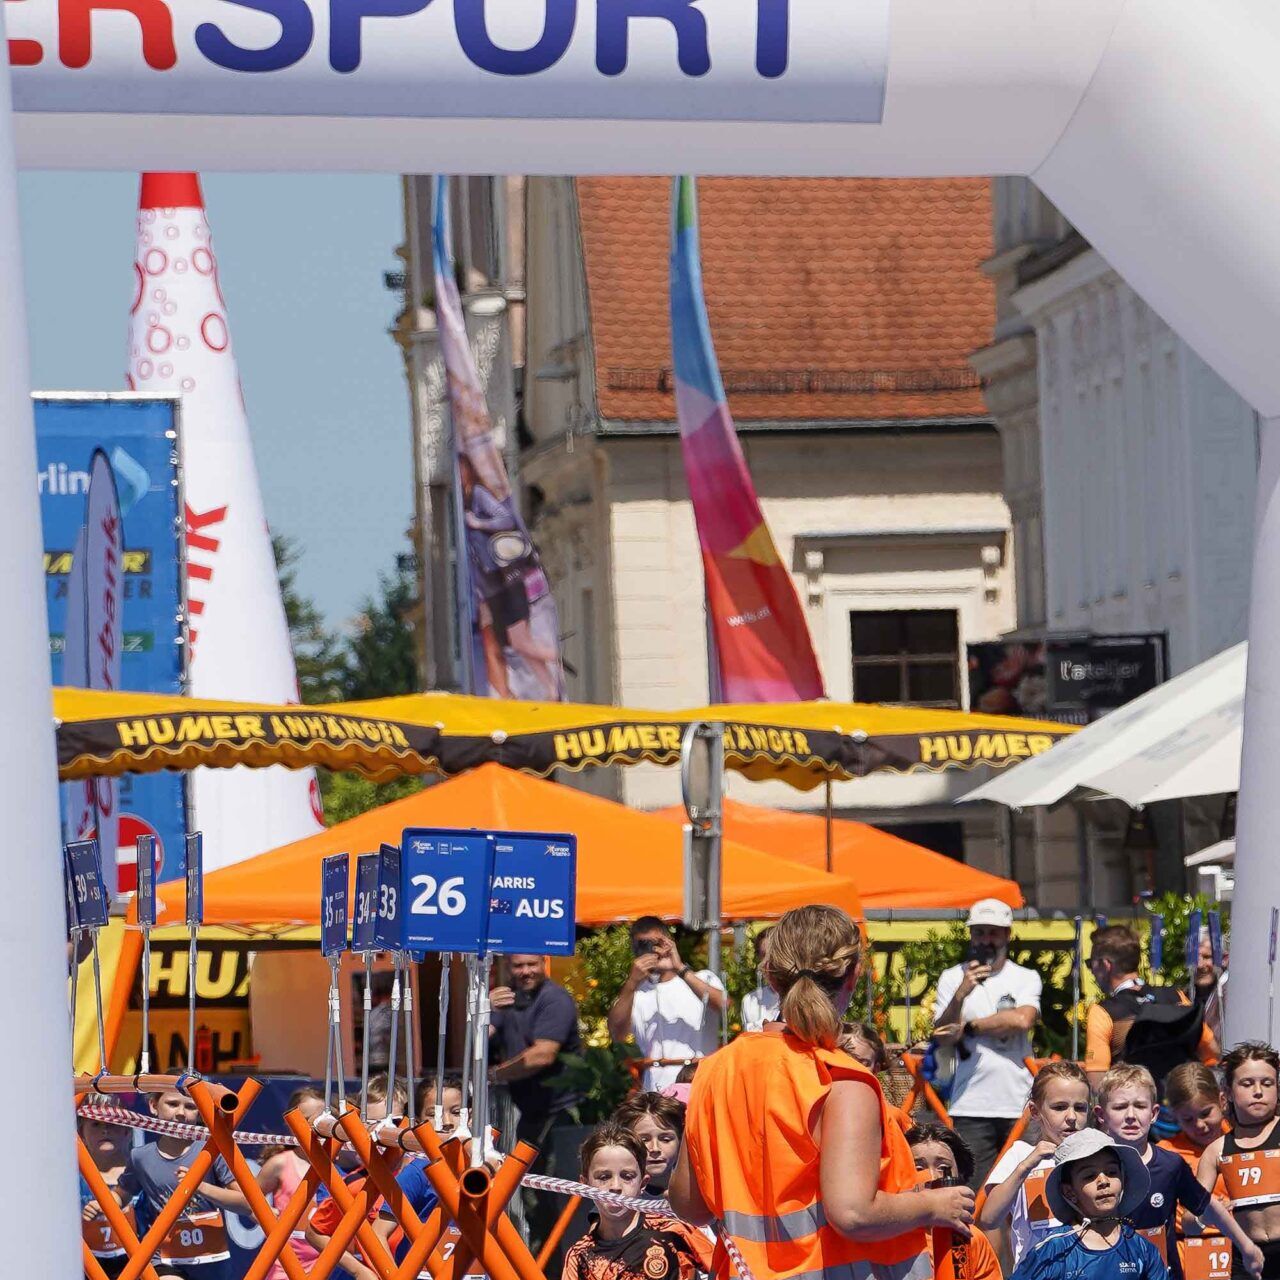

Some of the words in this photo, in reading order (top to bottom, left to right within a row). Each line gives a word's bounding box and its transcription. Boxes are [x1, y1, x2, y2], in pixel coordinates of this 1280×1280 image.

[117, 714, 267, 747] HUMER
[271, 714, 410, 749] ANHÄNGER
[554, 724, 681, 760] HUMER
[722, 724, 811, 755] HÄNGER
[918, 733, 1054, 762] HUMER
[75, 874, 87, 903] 39
[410, 874, 466, 917] 26
[490, 875, 536, 890] ARRIS
[357, 891, 370, 925] 34
[379, 884, 397, 920] 33
[515, 899, 565, 919] AUS
[150, 950, 250, 999] HU
[1238, 1167, 1261, 1186] 79
[101, 1227, 112, 1242] 7
[180, 1228, 203, 1246] 80
[1208, 1252, 1230, 1270] 19
